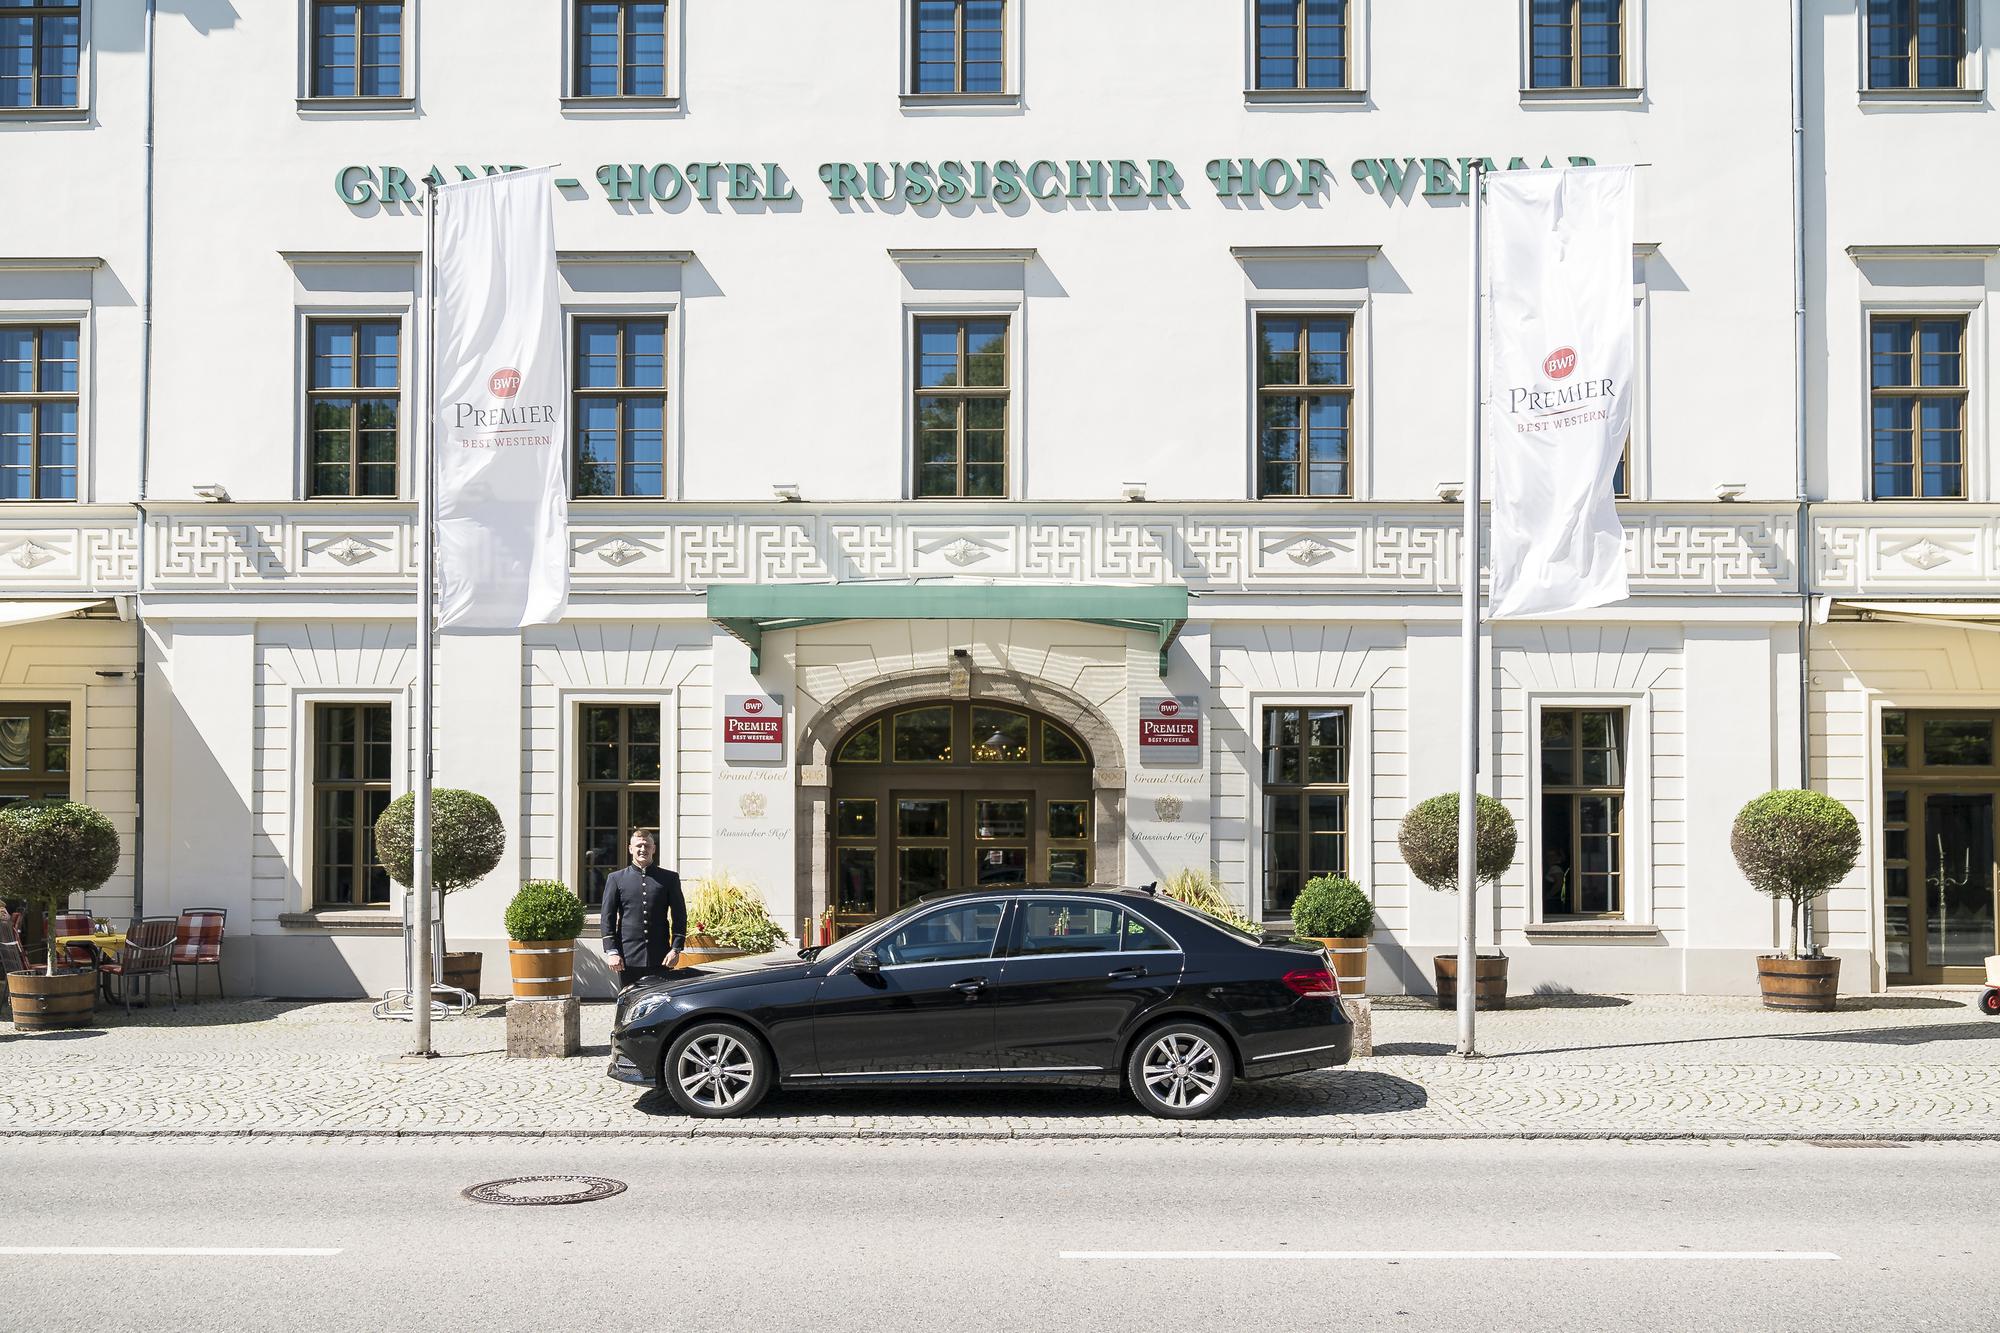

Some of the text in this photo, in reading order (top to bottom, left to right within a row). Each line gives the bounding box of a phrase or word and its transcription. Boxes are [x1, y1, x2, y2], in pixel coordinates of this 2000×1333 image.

[596, 162, 794, 201] HOTEL
[818, 159, 1182, 204] RUSSISCHER
[1205, 157, 1328, 197] HOF
[1548, 354, 1575, 372] BWP
[493, 376, 520, 390] BWP
[1508, 378, 1616, 414] PREMIER
[454, 402, 556, 428] PREMIER
[1517, 421, 1549, 433] BEST
[462, 439, 492, 449] BEST
[745, 702, 762, 710] BWP
[1160, 704, 1178, 713] BWP
[728, 718, 778, 732] PREMIER
[1144, 721, 1194, 734] PREMIER
[718, 770, 788, 781] Grand Hotel
[1133, 773, 1204, 784] Grand Hotel
[716, 826, 791, 840] Russischer Hof
[1131, 831, 1207, 844] Russischer Hof
